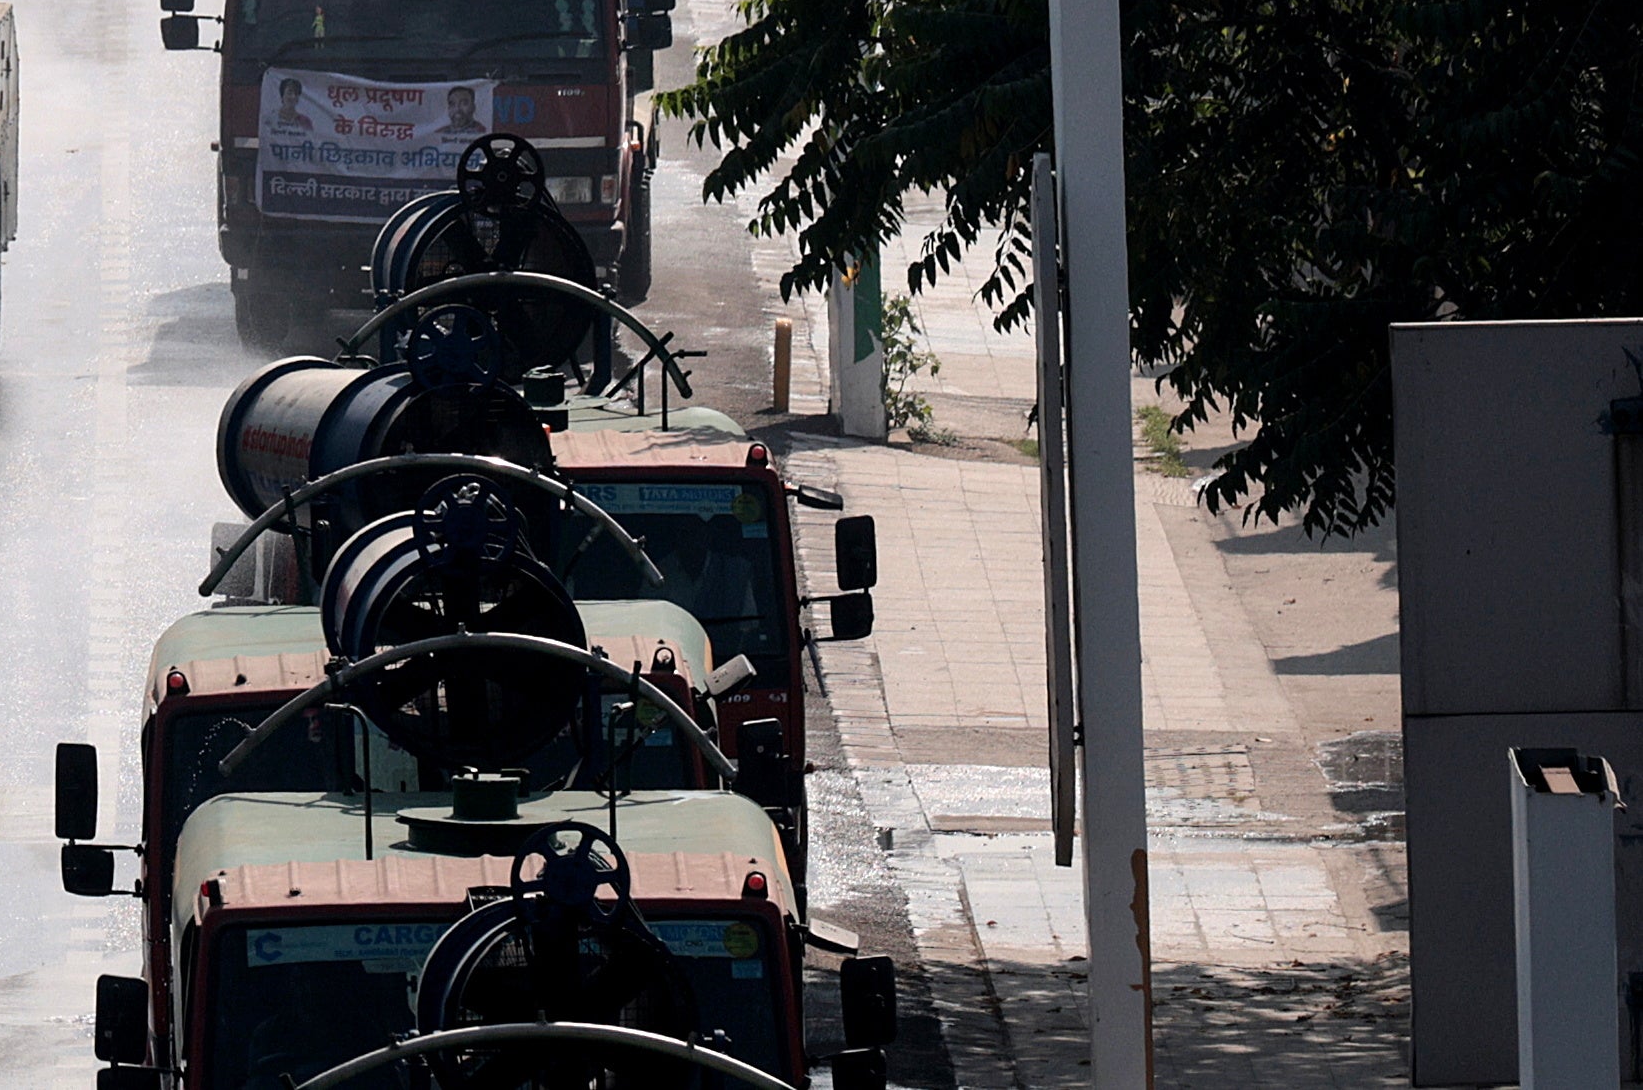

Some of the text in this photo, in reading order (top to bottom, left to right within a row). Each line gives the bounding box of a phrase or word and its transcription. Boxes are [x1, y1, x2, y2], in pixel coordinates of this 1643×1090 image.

[327, 85, 425, 112] धूल प्रदूषण
[334, 114, 354, 137] के
[358, 116, 415, 141] विरुद्ध
[270, 140, 314, 161] पानी
[319, 141, 396, 170] छिड़काव
[270, 177, 317, 199] दिल्ली
[321, 182, 376, 200] सरकार
